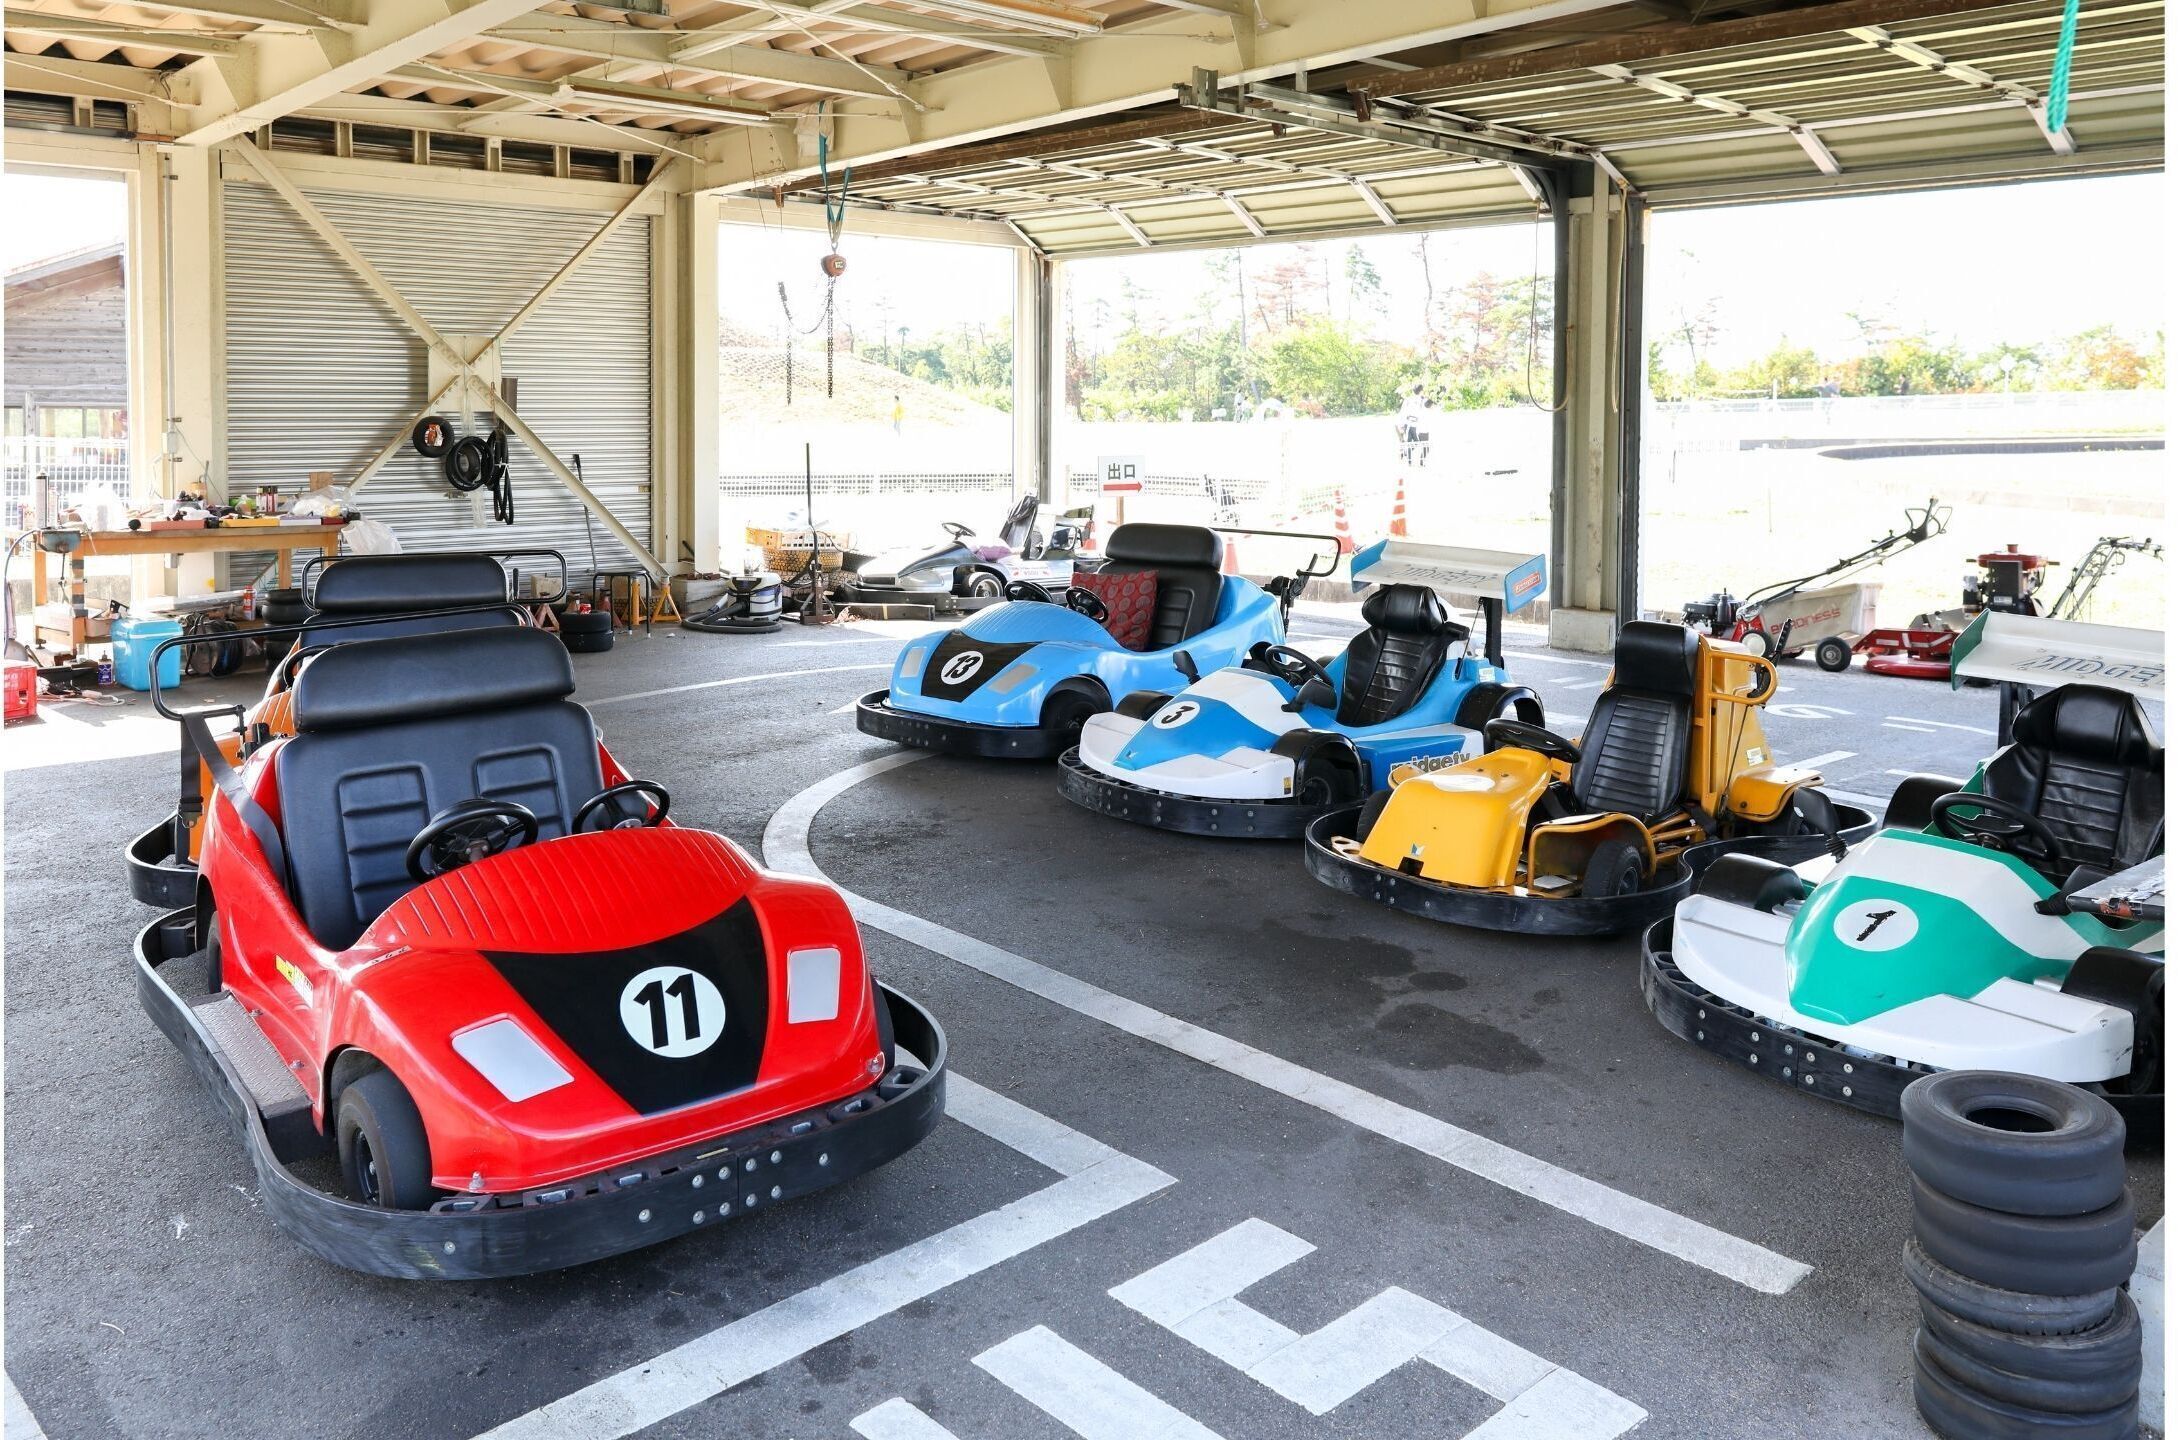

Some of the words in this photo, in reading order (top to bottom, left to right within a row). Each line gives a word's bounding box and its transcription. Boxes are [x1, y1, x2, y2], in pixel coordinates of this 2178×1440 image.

[1107, 462, 1135, 480] 出口
[943, 654, 981, 679] 13
[2010, 654, 2166, 687] MIDGE
[1160, 705, 1196, 725] 3
[1855, 909, 1897, 942] 1
[632, 972, 701, 1050] 11
